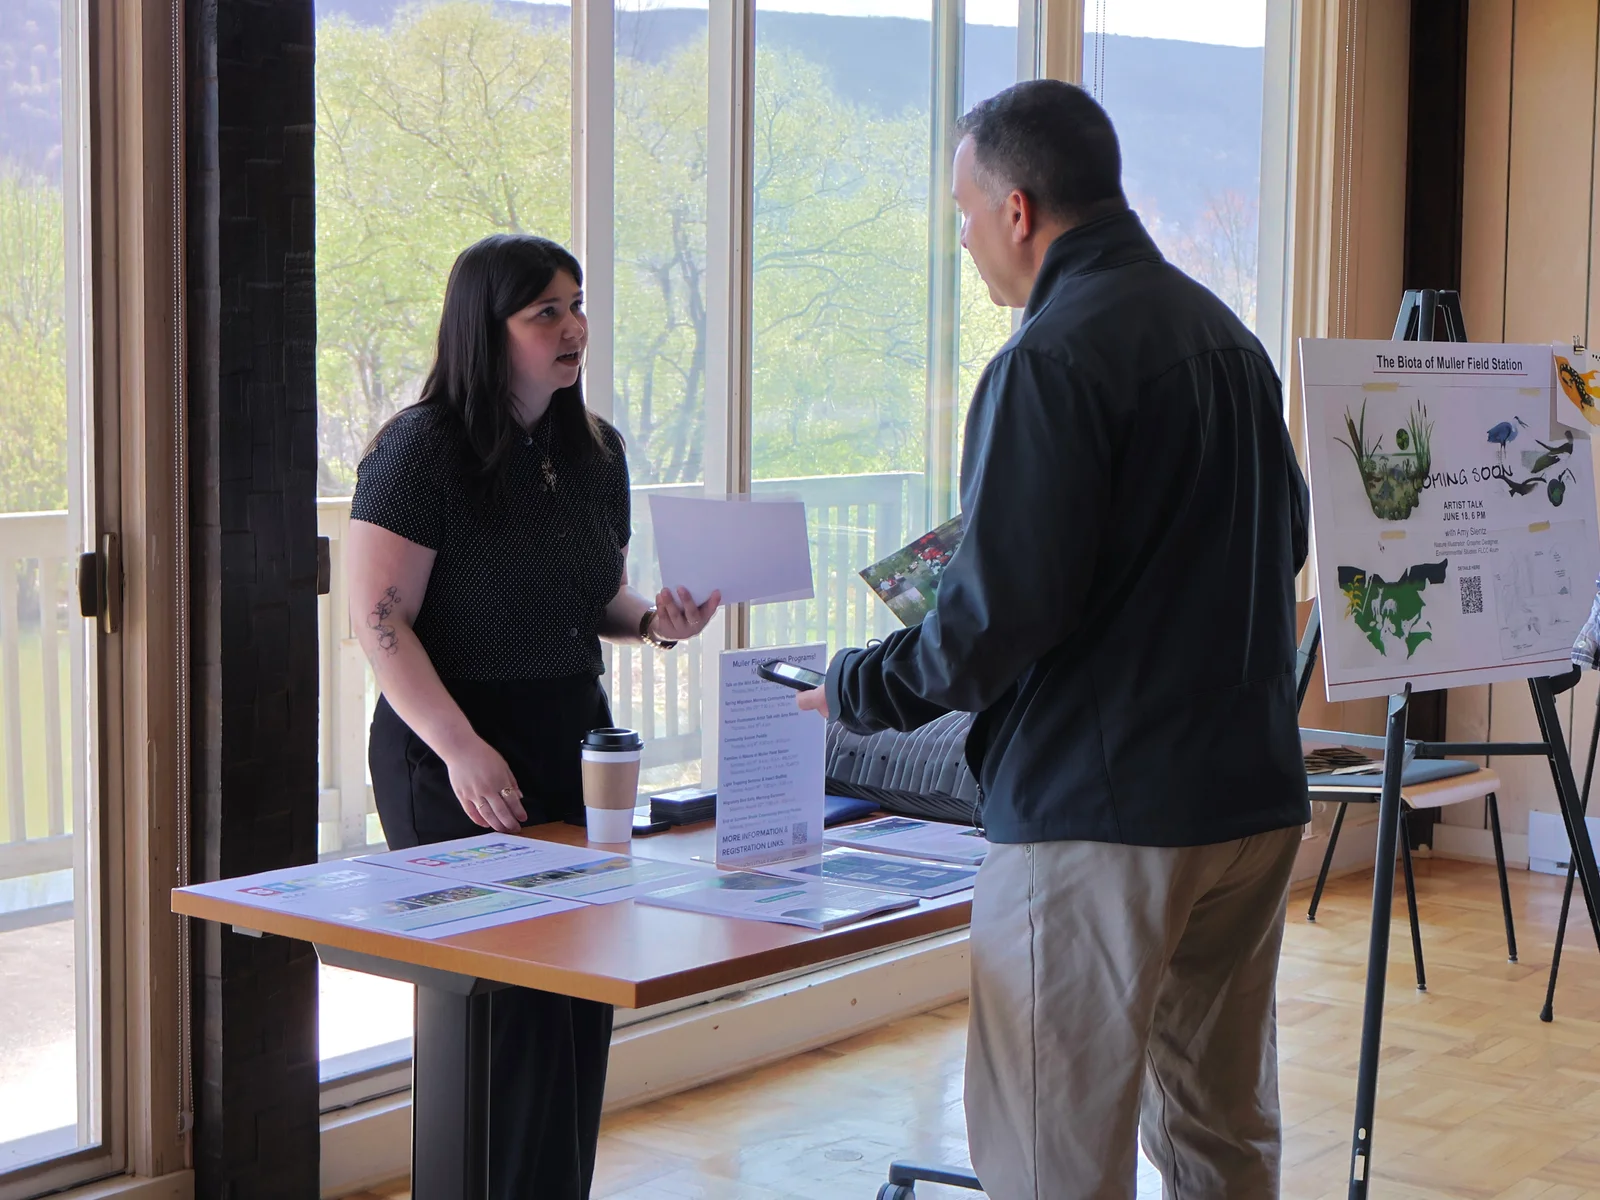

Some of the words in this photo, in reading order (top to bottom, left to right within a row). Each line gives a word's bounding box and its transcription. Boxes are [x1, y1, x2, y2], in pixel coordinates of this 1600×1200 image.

[1376, 355, 1395, 368] The
[1397, 356, 1422, 369] Biota
[1425, 356, 1435, 369] of
[1437, 356, 1465, 370] Muller
[1467, 357, 1490, 370] Field
[1491, 358, 1523, 371] Station
[1471, 464, 1514, 483] SOON
[1443, 500, 1466, 510] ARTIST
[1467, 500, 1484, 509] TALK
[1443, 512, 1460, 521] JUNE
[1471, 512, 1476, 520] 6
[1476, 511, 1486, 520] PM
[1457, 528, 1468, 538] Amy
[788, 653, 816, 663] Programs!
[722, 834, 741, 843] MORE
[741, 826, 784, 840] INFORMATION
[722, 842, 766, 856] REGISTRATION
